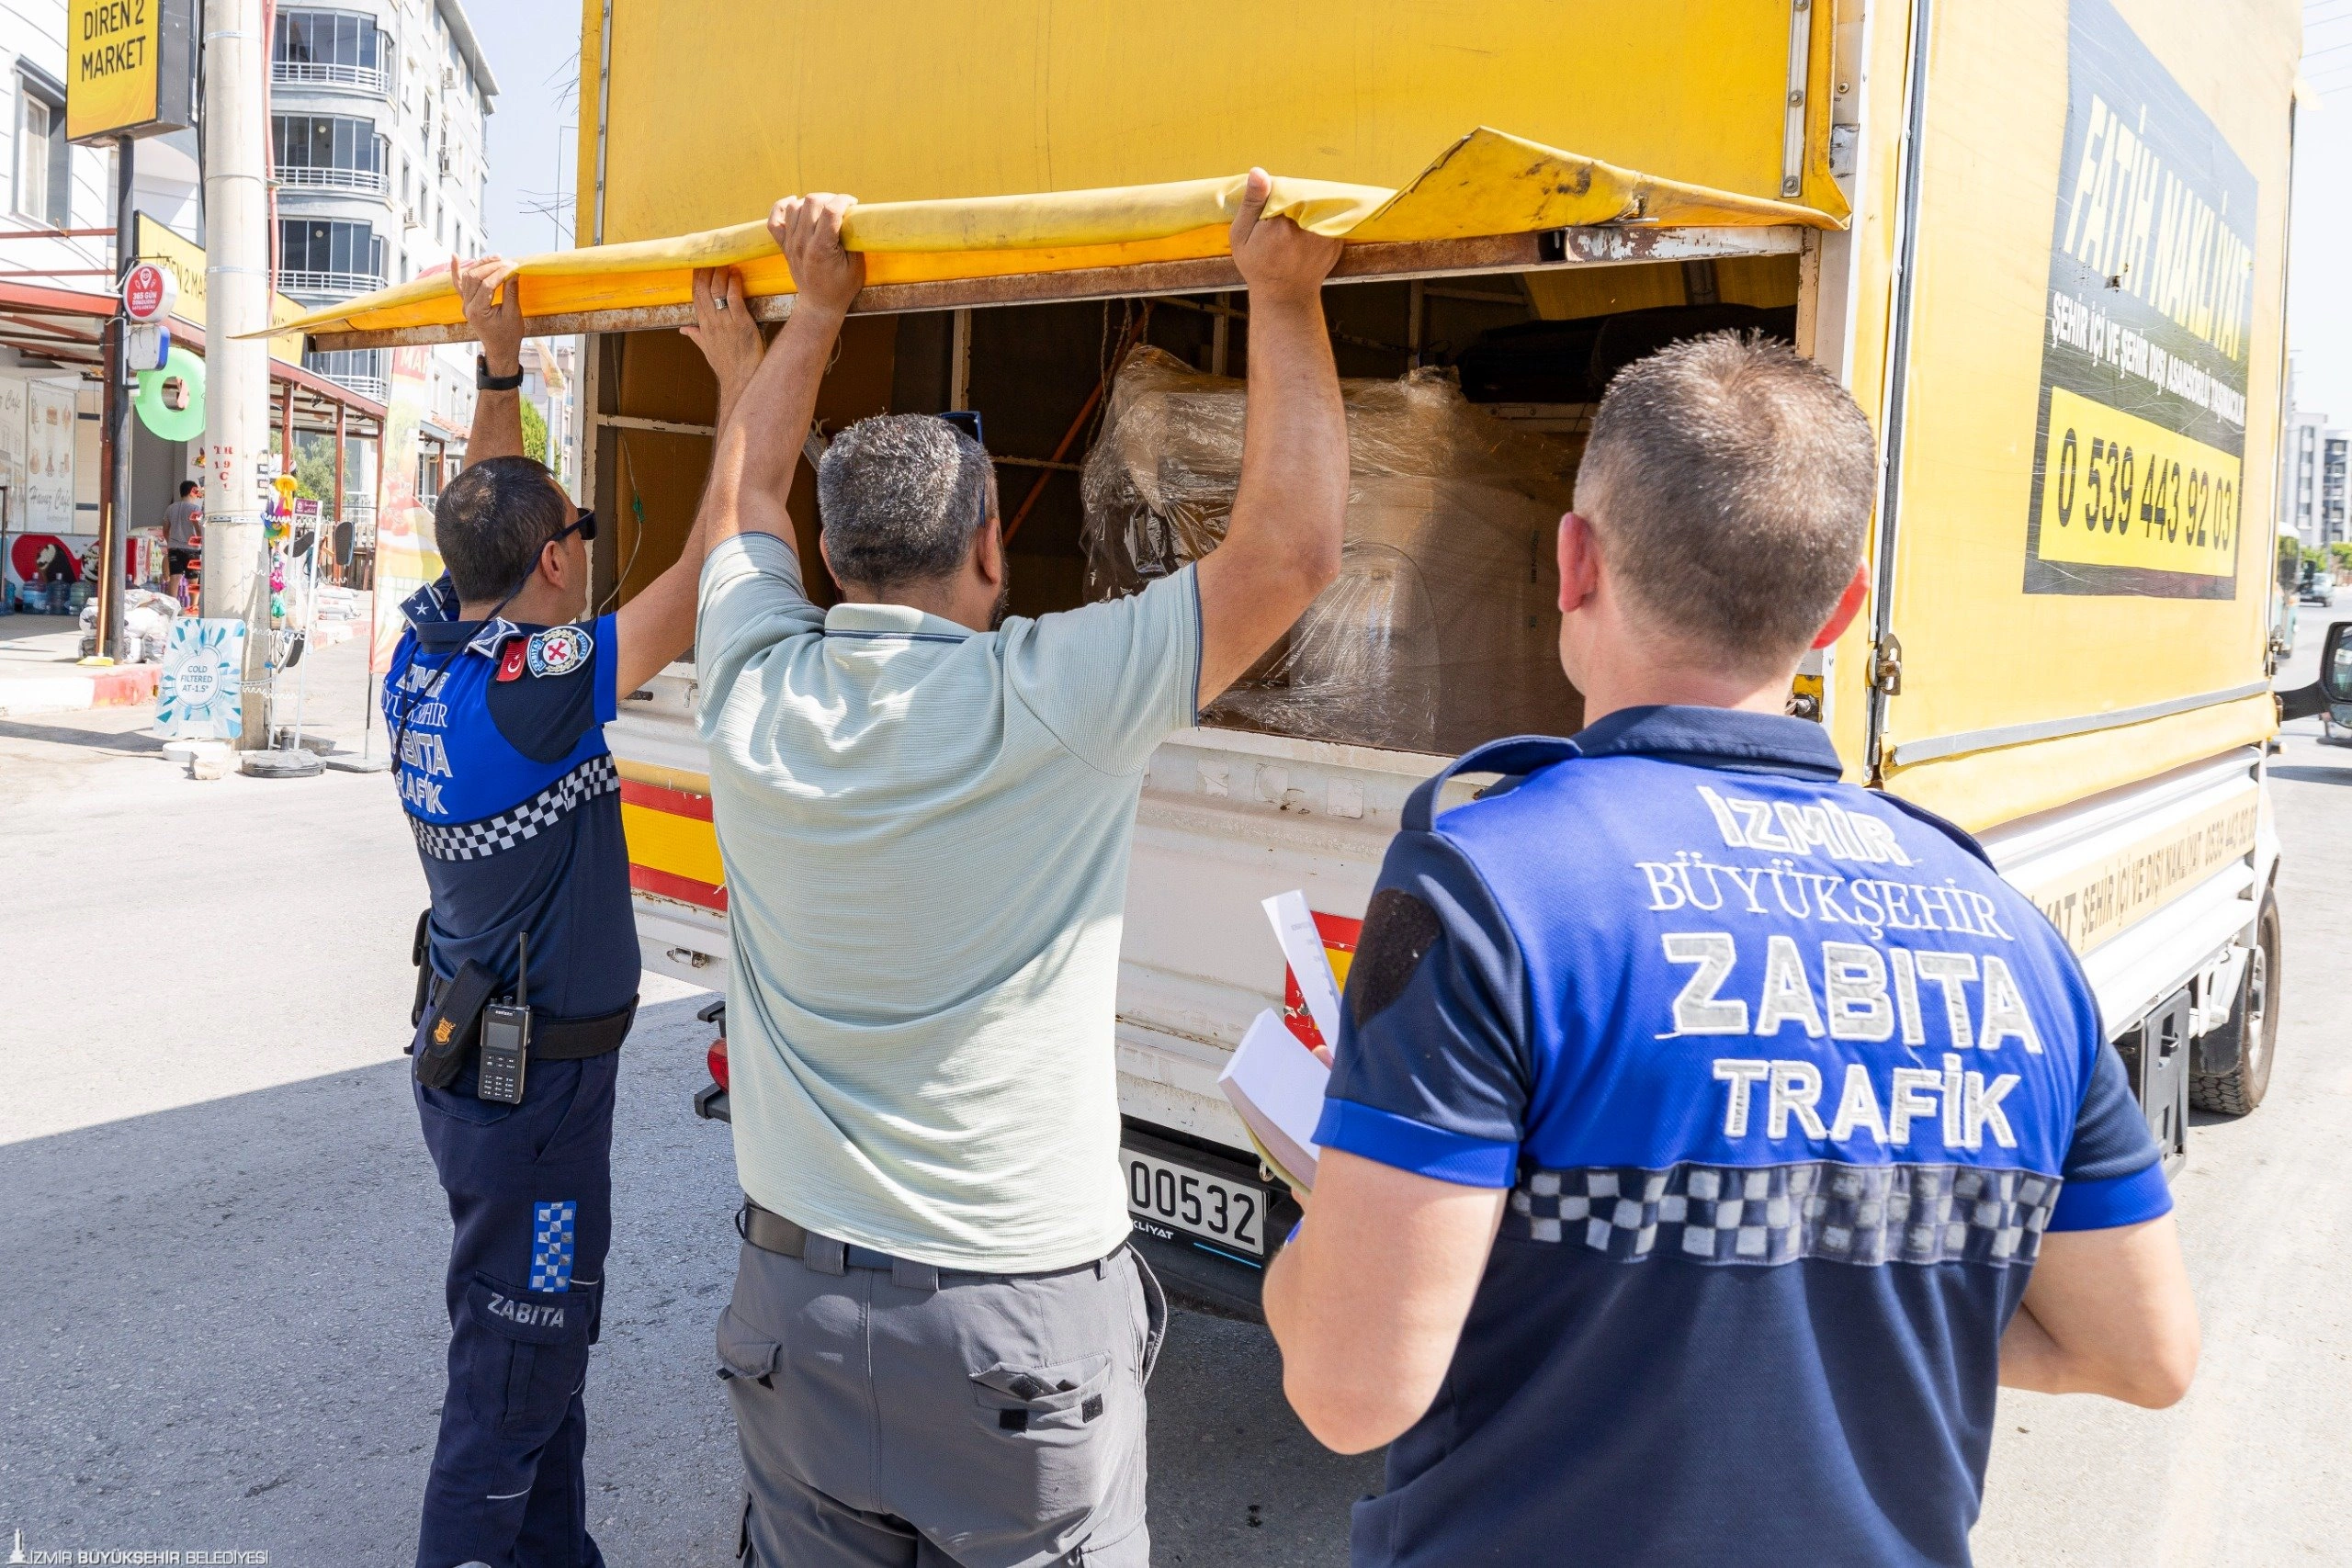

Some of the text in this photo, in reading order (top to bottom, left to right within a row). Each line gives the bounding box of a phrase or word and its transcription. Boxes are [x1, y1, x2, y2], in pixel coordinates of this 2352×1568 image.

[81, 35, 146, 82] MARKET
[84, 0, 145, 40] DİREN 2
[2064, 93, 2252, 362] FATİH NAKLİYAT
[2052, 291, 2089, 351] ŞEHİR
[2088, 300, 2107, 367] İÇİ
[2106, 319, 2120, 366] VE
[2120, 328, 2149, 379] ŞEHİR
[2058, 427, 2232, 552] 0 539 443 92 03
[180, 674, 213, 683] FILTERED
[187, 665, 208, 673] COLD
[1696, 785, 1914, 868] İZMİR
[1634, 850, 2016, 941] BÜYÜKŞEHİR
[2132, 857, 2145, 907] VE
[1661, 932, 2044, 1054] ZABITA
[1712, 1053, 2021, 1148] TRAFİK
[1130, 1160, 1256, 1246] 00532
[487, 1292, 565, 1328] ZABITA
